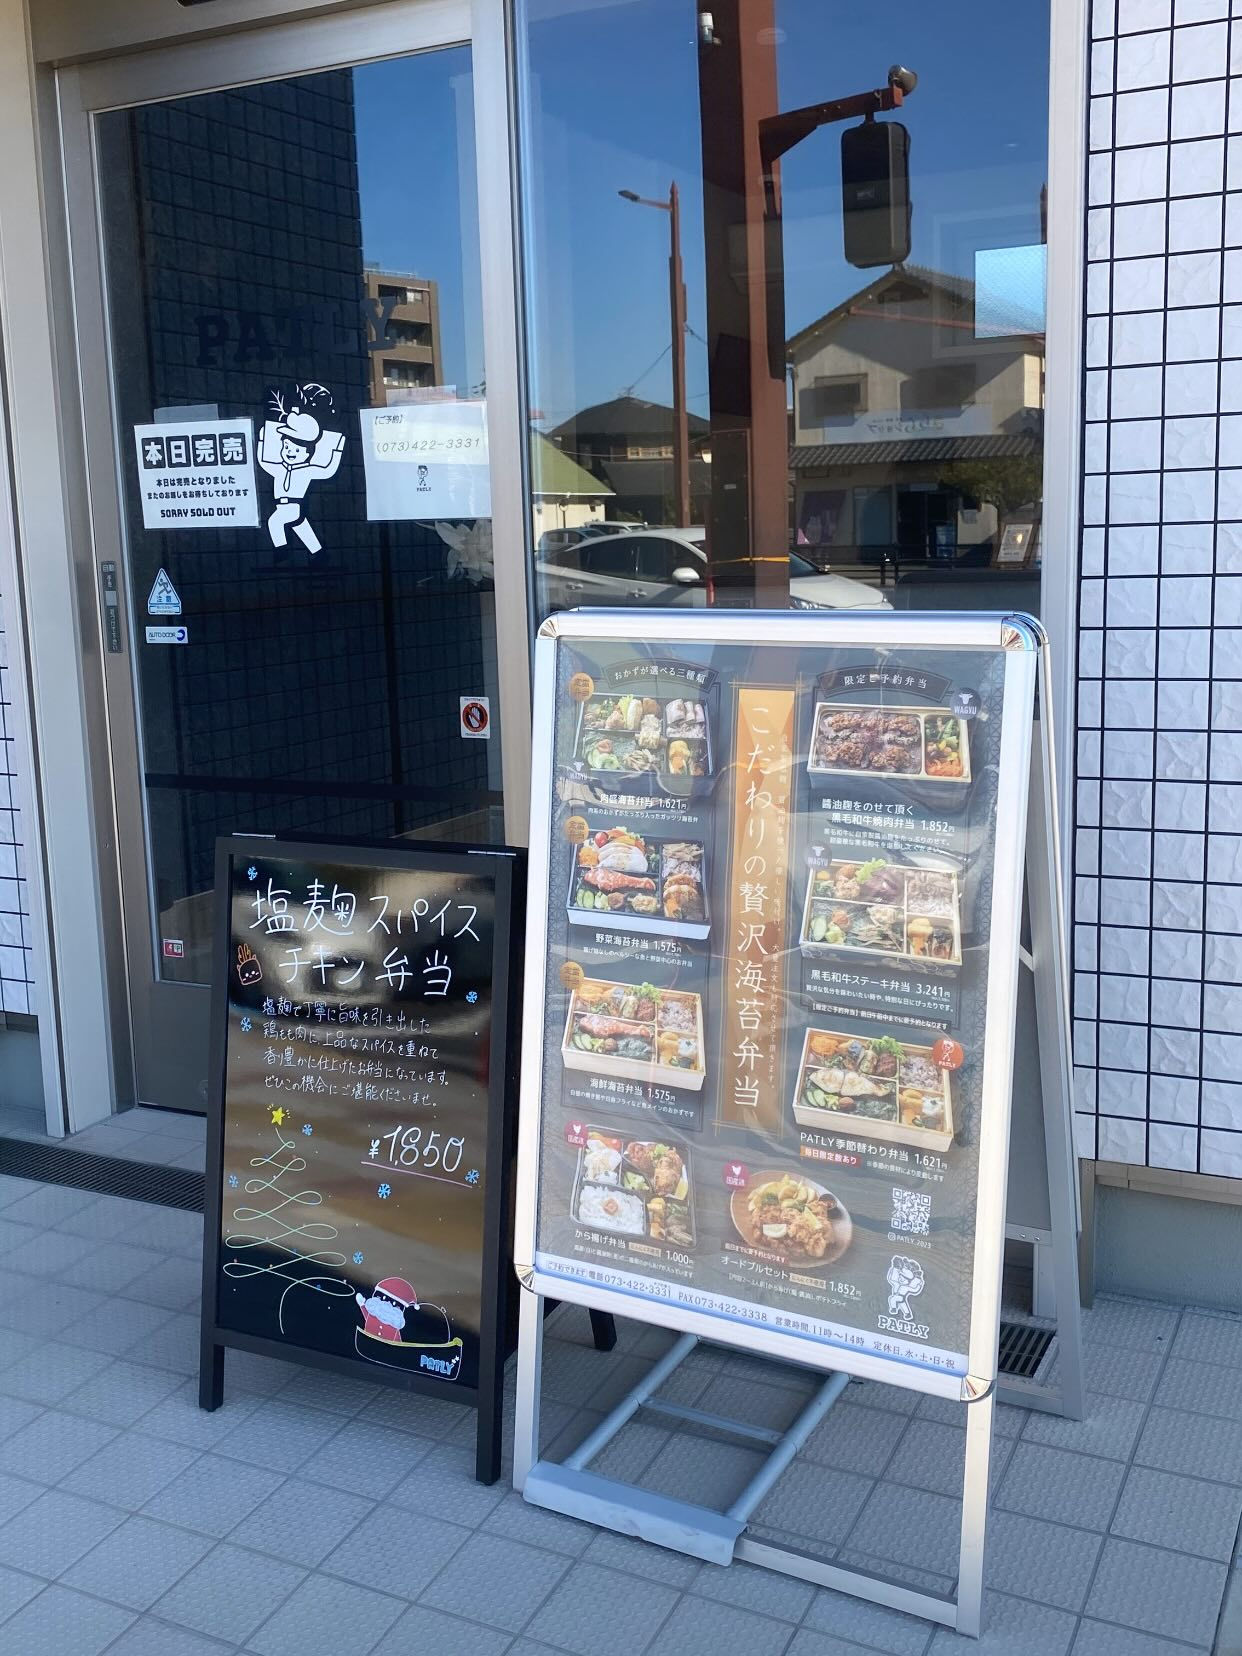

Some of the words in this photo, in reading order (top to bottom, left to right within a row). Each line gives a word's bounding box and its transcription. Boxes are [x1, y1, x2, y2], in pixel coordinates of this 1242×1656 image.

[374, 414, 403, 425] 【ご予約】
[142, 435, 246, 467] 本日完売
[376, 438, 480, 454] (073)422-3331
[156, 476, 236, 487] 本日は完売となりました
[147, 489, 249, 500] またのお越しをお待ちしております
[160, 509, 188, 518] SORRY
[190, 508, 215, 517] SOLD
[217, 507, 236, 516] OUT
[615, 665, 708, 685] おかずが選べる三種類
[954, 705, 977, 714] WAGYU
[600, 794, 653, 807] 肉盛海苔弁当
[831, 814, 915, 830] 黒毛和牛焼肉弁当
[733, 707, 772, 1107] こだわりの贅沢海苔弁当
[595, 933, 649, 949] 野菜海苔弁当
[811, 969, 910, 993] 黒毛和牛ステーキ弁当
[262, 996, 431, 1034] 塩麹で丁寧に旨味を引き出した
[263, 1045, 450, 1086] 香り豊かに仕上げたお弁当になっています。
[264, 1074, 437, 1107] ぜひこの機会にご堪能くださいませ。
[590, 1078, 643, 1096] 海鮮海苔弁当
[800, 1132, 909, 1162] PATLY季節替わり弁当
[575, 1230, 626, 1248] から揚げ弁当
[720, 1256, 789, 1279] オードブルセット
[877, 1315, 930, 1339] PATLY
[420, 1354, 455, 1375] PATLY
